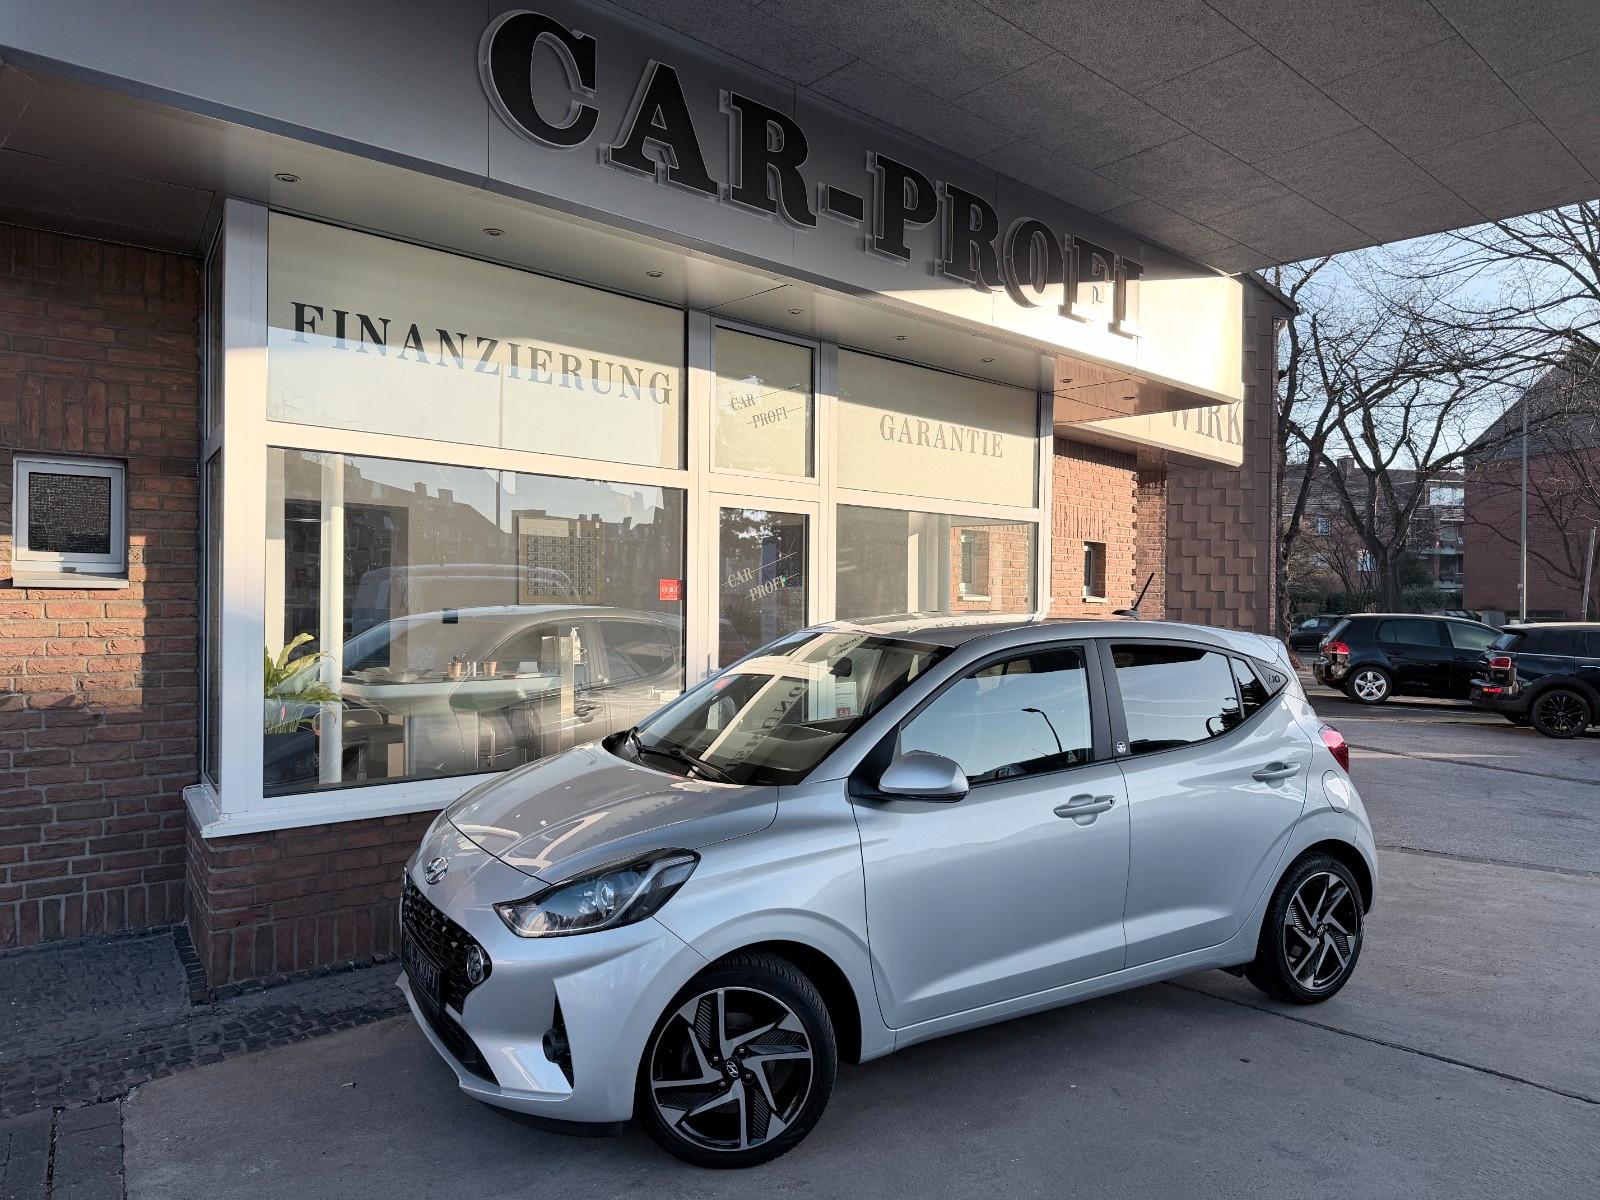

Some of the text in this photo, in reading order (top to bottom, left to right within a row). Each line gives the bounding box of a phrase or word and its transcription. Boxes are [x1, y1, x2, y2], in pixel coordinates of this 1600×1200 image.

[480, 9, 1144, 339] CAR-PROFI
[291, 301, 673, 406] FINANZIERUNG
[730, 393, 756, 411] CAR
[751, 406, 788, 429] PROFI
[879, 413, 1004, 458] GARANTIE
[727, 567, 753, 588] CAR
[750, 574, 785, 602] PROFI
